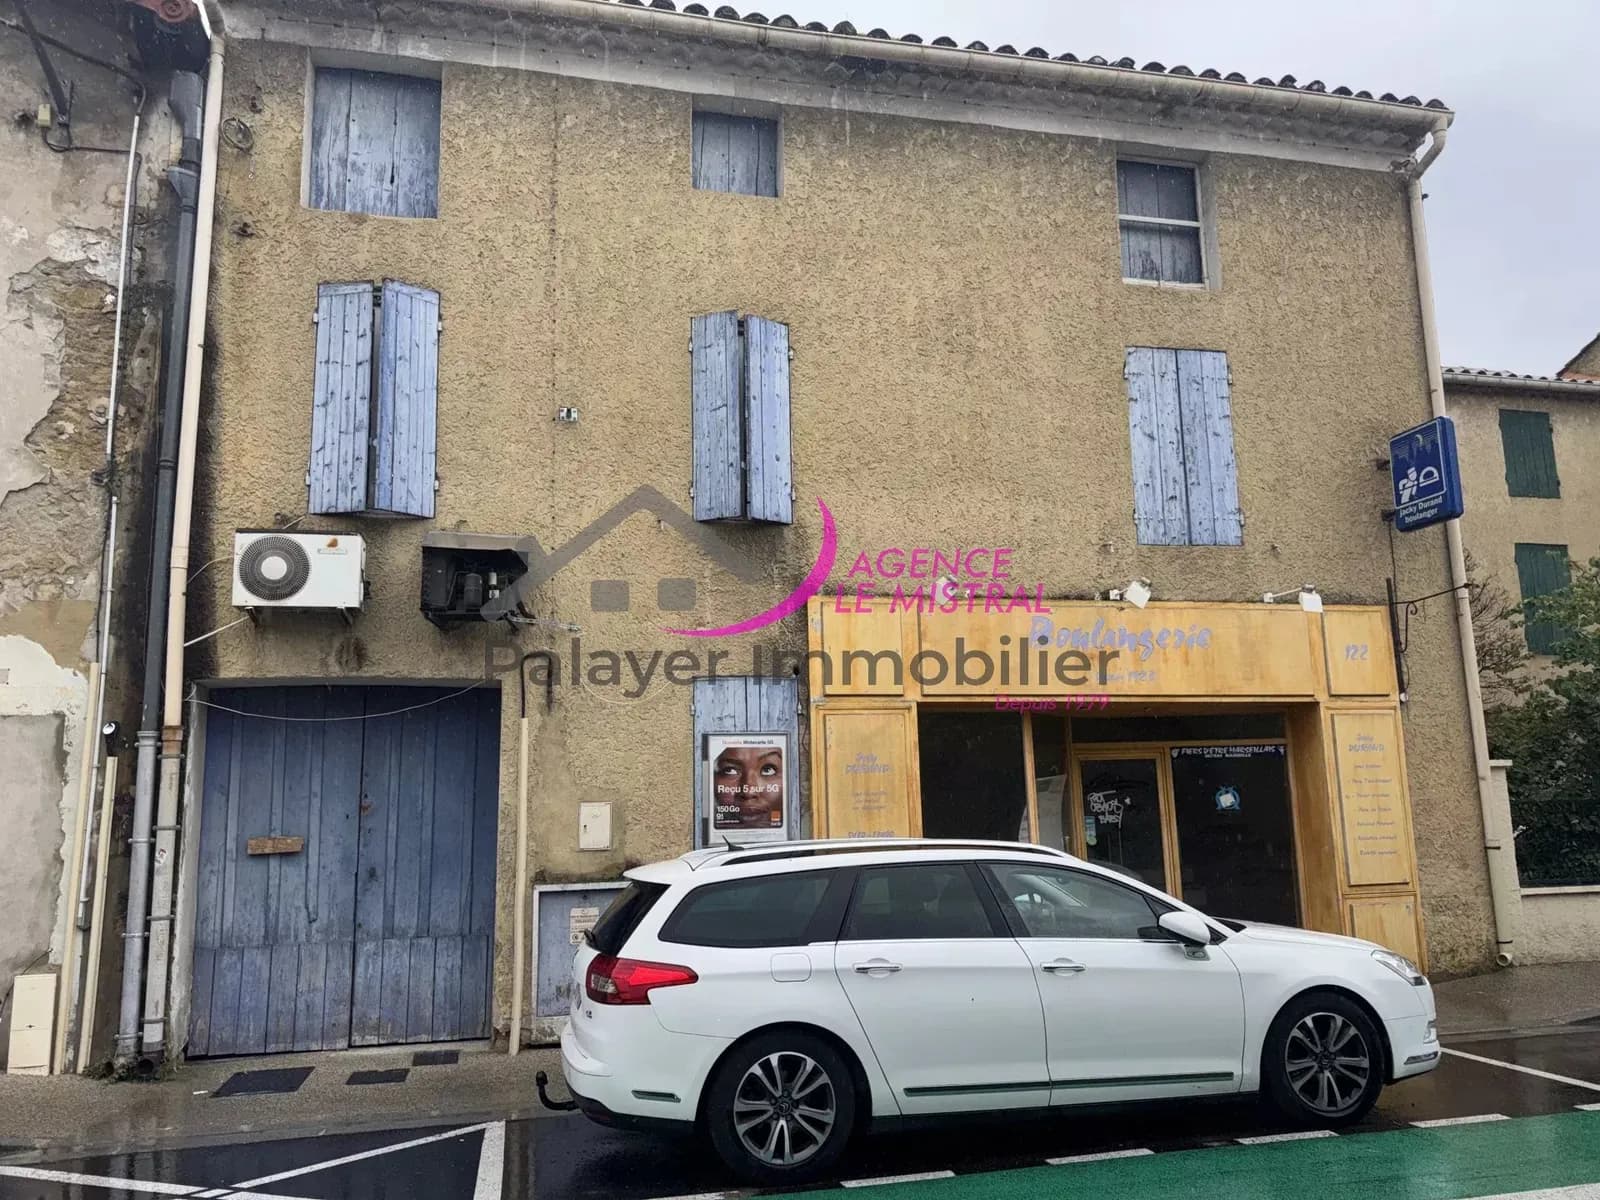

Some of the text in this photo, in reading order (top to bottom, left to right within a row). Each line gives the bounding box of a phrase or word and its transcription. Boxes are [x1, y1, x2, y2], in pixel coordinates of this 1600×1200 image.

[1400, 504, 1418, 518] Jacky
[1030, 615, 1213, 662] Boulangerie
[1345, 643, 1369, 661] 122
[717, 783, 779, 795] Reçu 5 sur 5G
[716, 805, 740, 813] 150 Go
